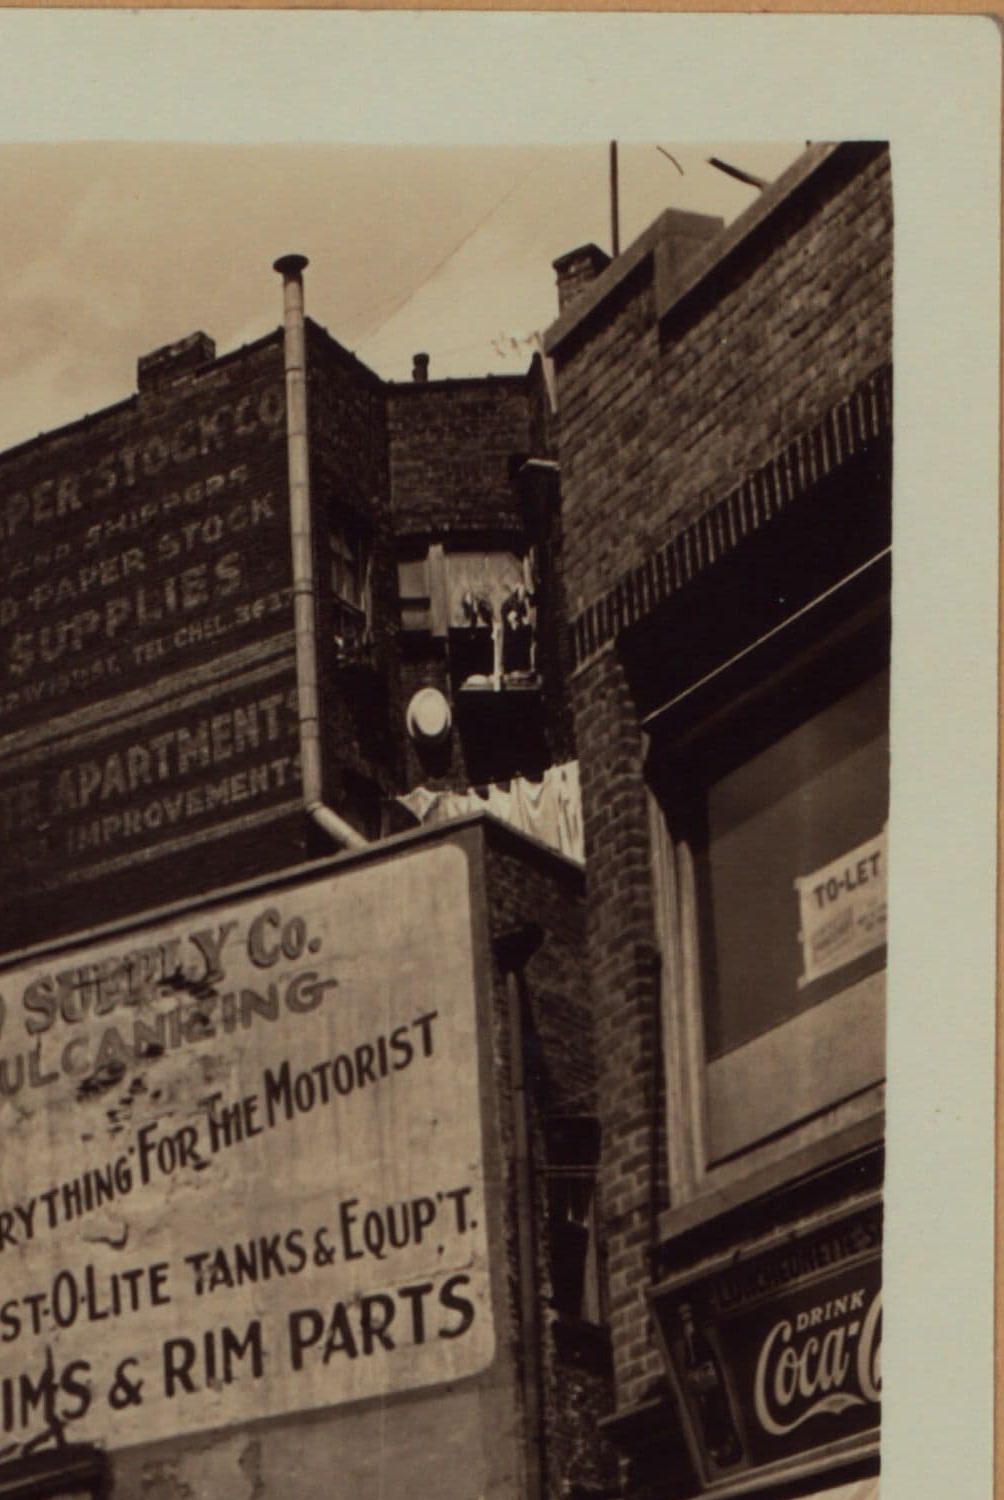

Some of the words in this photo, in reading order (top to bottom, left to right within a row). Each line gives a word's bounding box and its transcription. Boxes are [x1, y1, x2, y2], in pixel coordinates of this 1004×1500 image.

[92, 412, 226, 500] STOCK
[30, 548, 146, 611] PAPER
[158, 492, 277, 562] STOCK
[8, 550, 243, 678] SUPPLIES
[812, 847, 883, 910] TO-LET
[23, 919, 239, 1037] SUPPLY
[135, 1121, 205, 1186] FOR
[205, 1092, 263, 1155] THE
[263, 1010, 439, 1127] MOTORIST
[185, 1227, 307, 1297] TANKS
[313, 1233, 335, 1266] &
[795, 1287, 867, 1334] DRINK
[108, 1357, 144, 1412] &
[163, 1319, 264, 1400] RIM
[289, 1275, 476, 1373] PARTS
